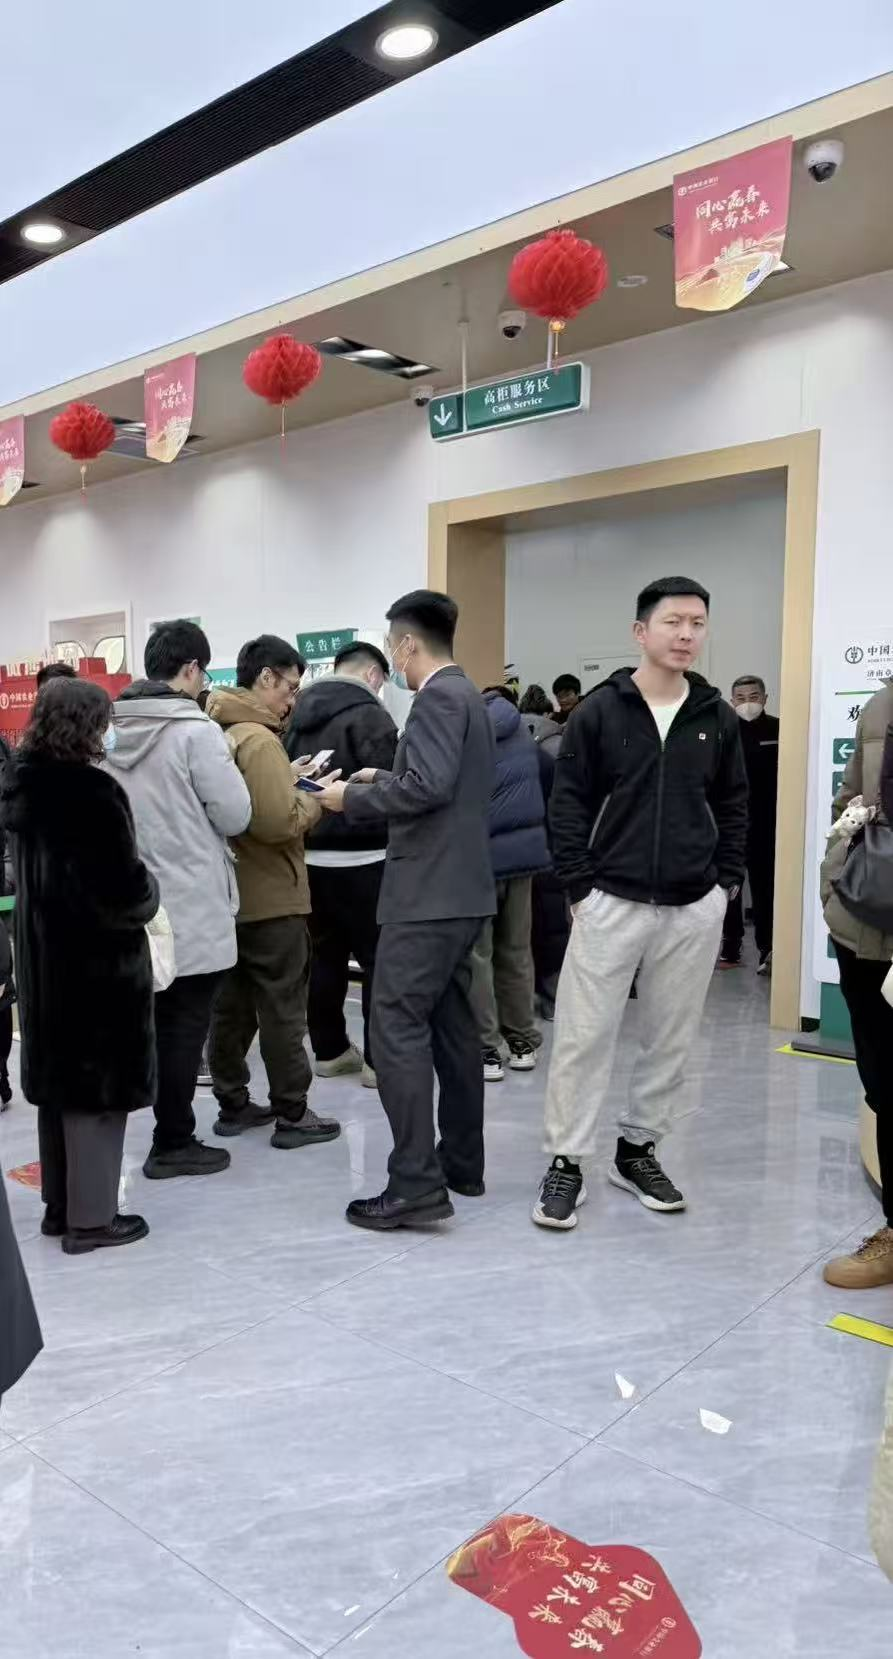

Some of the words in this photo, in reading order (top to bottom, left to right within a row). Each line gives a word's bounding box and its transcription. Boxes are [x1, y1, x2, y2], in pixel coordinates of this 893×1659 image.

[484, 376, 551, 406] 高柜服务区
[492, 404, 512, 415] Cash
[514, 396, 543, 410] Service
[305, 636, 343, 653] 公告栏
[867, 645, 893, 656] 中国
[527, 1554, 614, 1625] 共富未来
